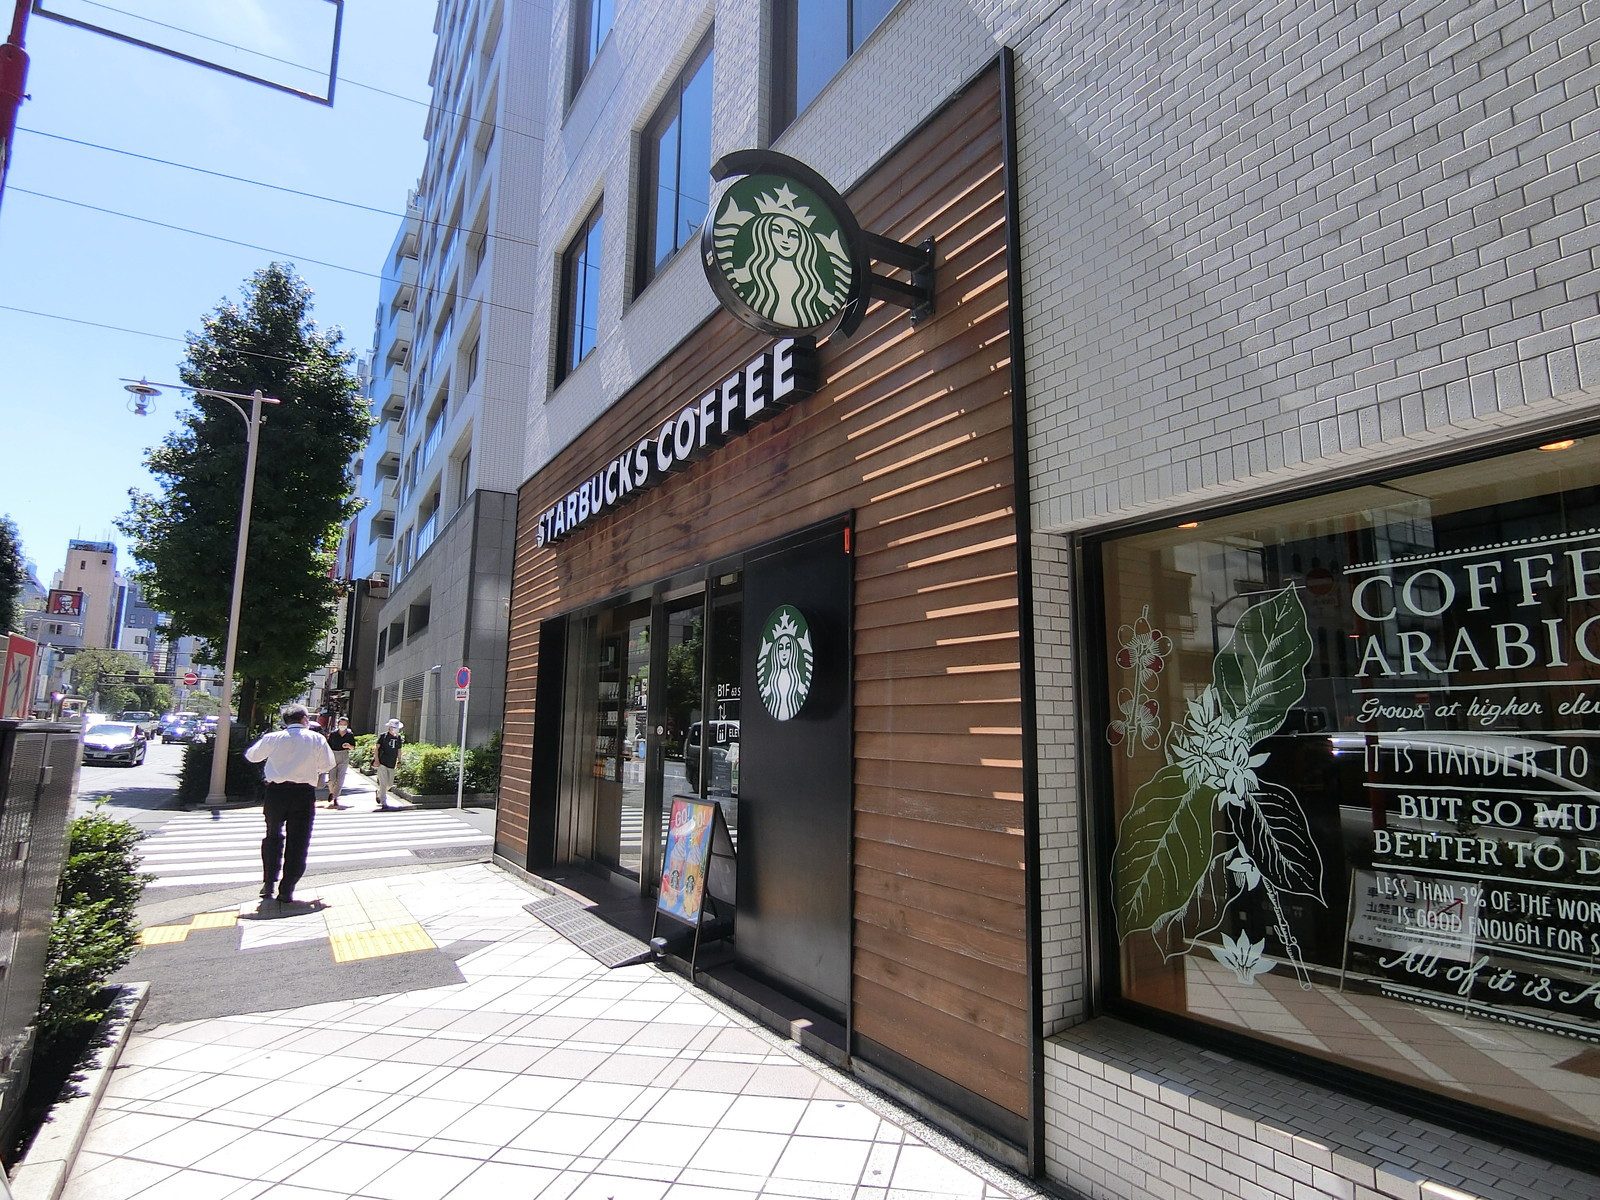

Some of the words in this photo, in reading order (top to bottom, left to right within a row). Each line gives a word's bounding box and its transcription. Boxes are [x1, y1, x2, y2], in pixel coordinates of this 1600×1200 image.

[536, 438, 650, 548] STARBUCKS
[657, 337, 795, 472] COFFEE
[1351, 547, 1600, 622] COFFE
[717, 683, 731, 697] B1F
[1356, 697, 1425, 723] Grows
[1434, 701, 1462, 717] at
[1466, 696, 1543, 726] higher
[1364, 745, 1383, 773] IT
[1394, 745, 1414, 773] IS
[1427, 745, 1538, 778] HARDER
[1549, 745, 1589, 778] TO
[1397, 794, 1463, 823] BUT
[1471, 799, 1522, 827] SO
[1534, 802, 1600, 832] MU
[1373, 829, 1503, 867] BETTER
[1508, 841, 1565, 871] TO
[1375, 876, 1408, 898] LESS
[1413, 880, 1455, 903] THAN
[1459, 886, 1487, 907] 3%
[1491, 890, 1515, 912] OF
[1517, 893, 1552, 917] THE
[1397, 906, 1410, 926] IS
[1416, 909, 1463, 933] GOOD
[1468, 916, 1541, 946] ENOUGH
[1547, 926, 1584, 954] FOR
[1378, 945, 1442, 978] All
[1446, 955, 1490, 995] of
[1487, 966, 1517, 992] it
[1522, 973, 1552, 1002] is
